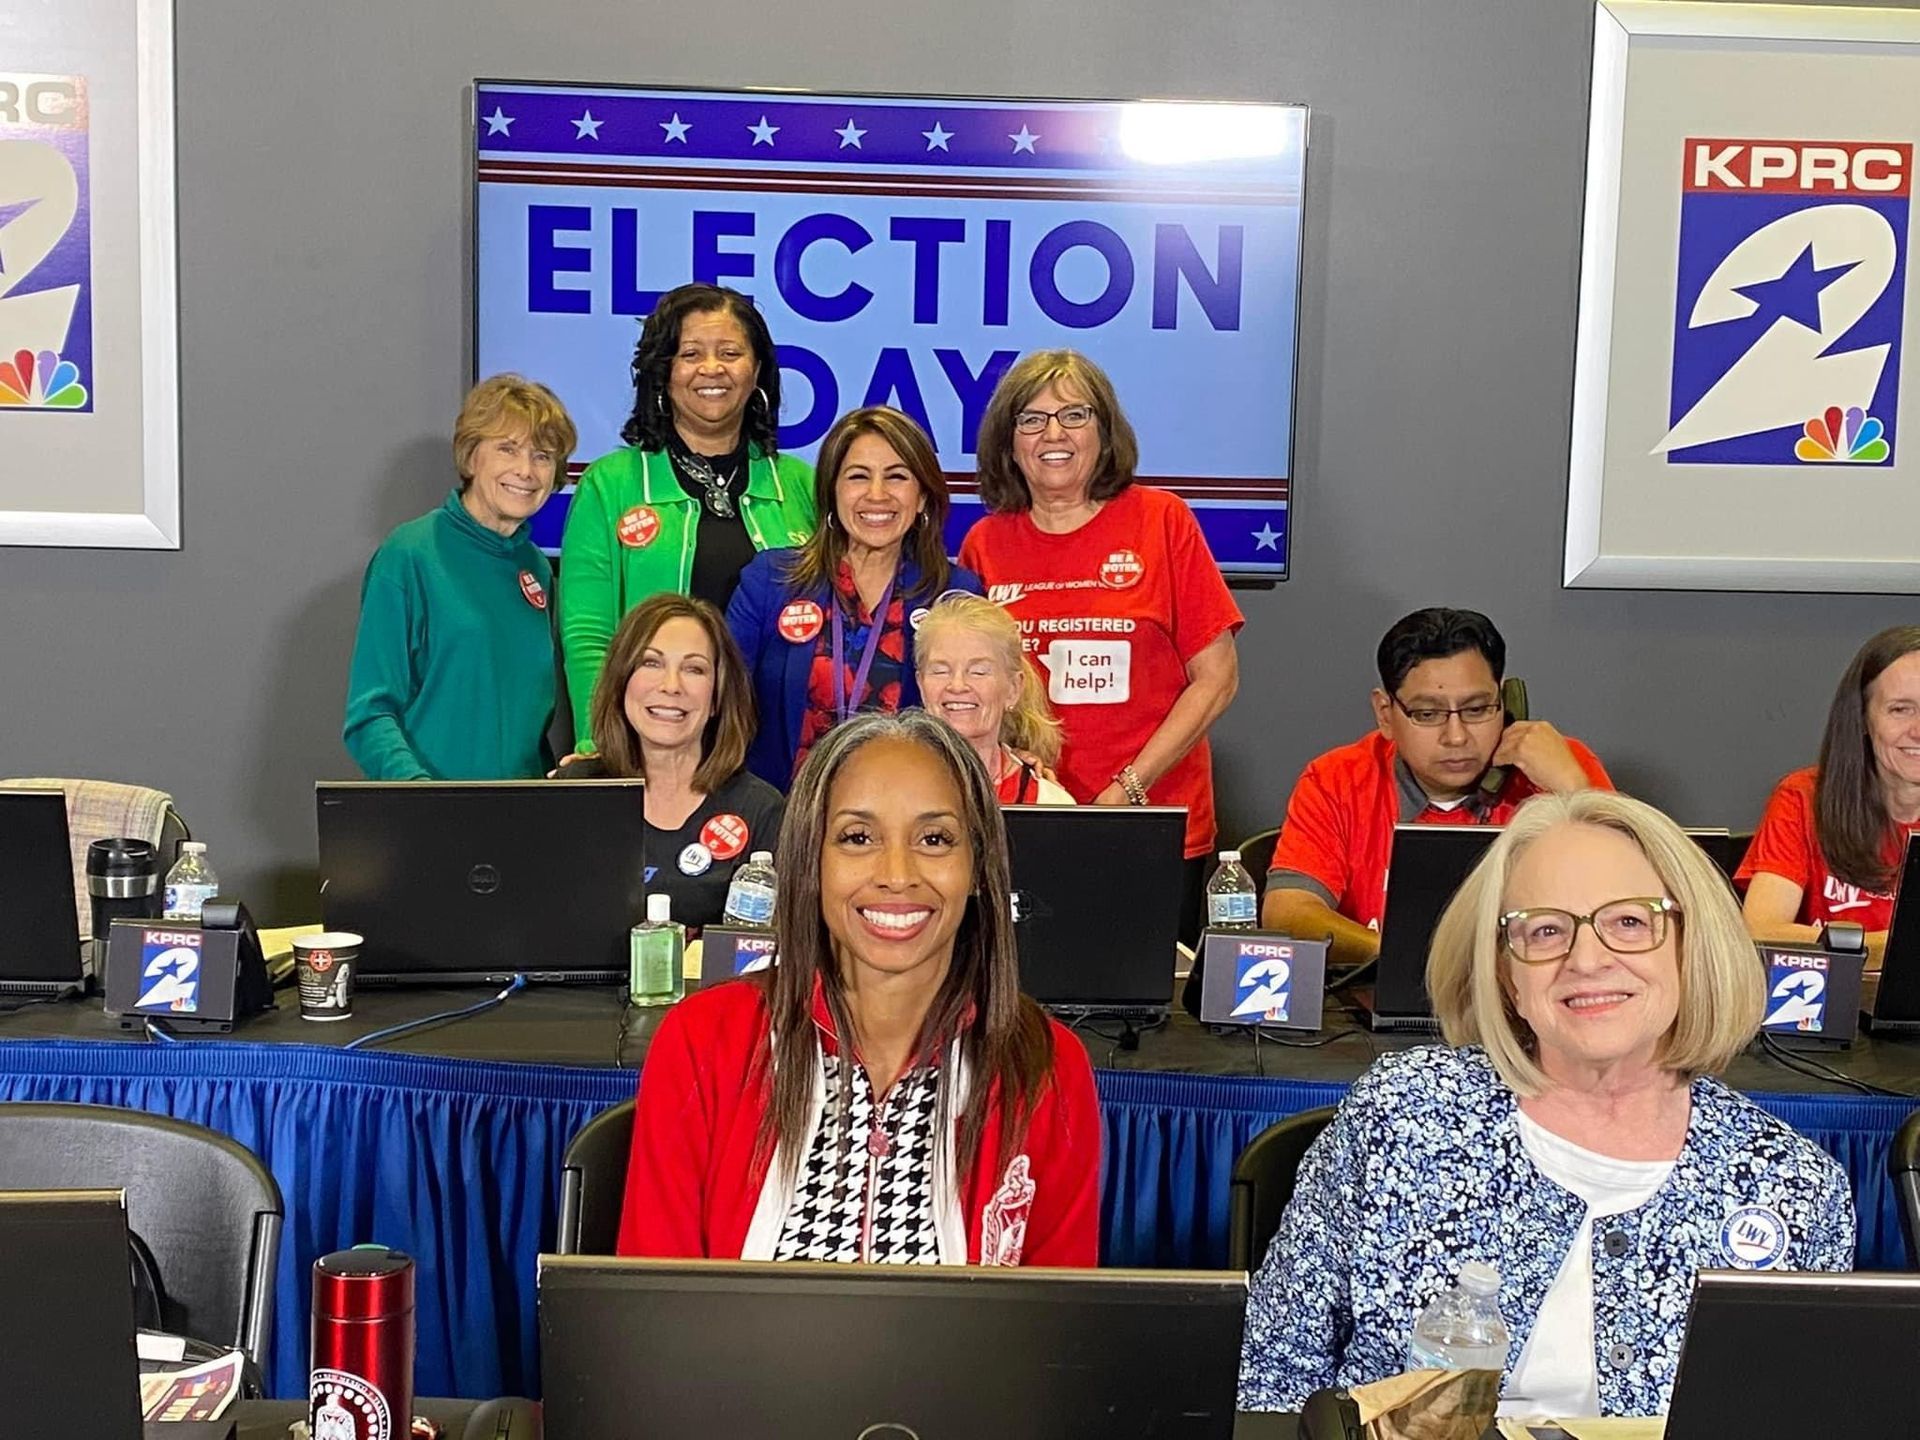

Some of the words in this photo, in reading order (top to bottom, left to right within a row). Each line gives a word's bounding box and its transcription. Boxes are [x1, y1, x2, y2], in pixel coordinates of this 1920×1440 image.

[1694, 145, 1902, 191] KPRC
[528, 204, 1244, 331] ELECTION
[775, 346, 1020, 455] DAY
[1023, 582, 1055, 592] LEAGUE
[1065, 580, 1096, 589] WOMEN
[1038, 617, 1136, 633] REGISTERED
[1068, 650, 1072, 666] I
[1079, 653, 1112, 667] can
[1064, 672, 1114, 693] help!
[146, 931, 201, 946] KPRC
[737, 938, 776, 954] KPR
[1240, 944, 1291, 958] KPRC
[1774, 954, 1827, 969] KPRC
[1737, 1220, 1772, 1245] LWV
